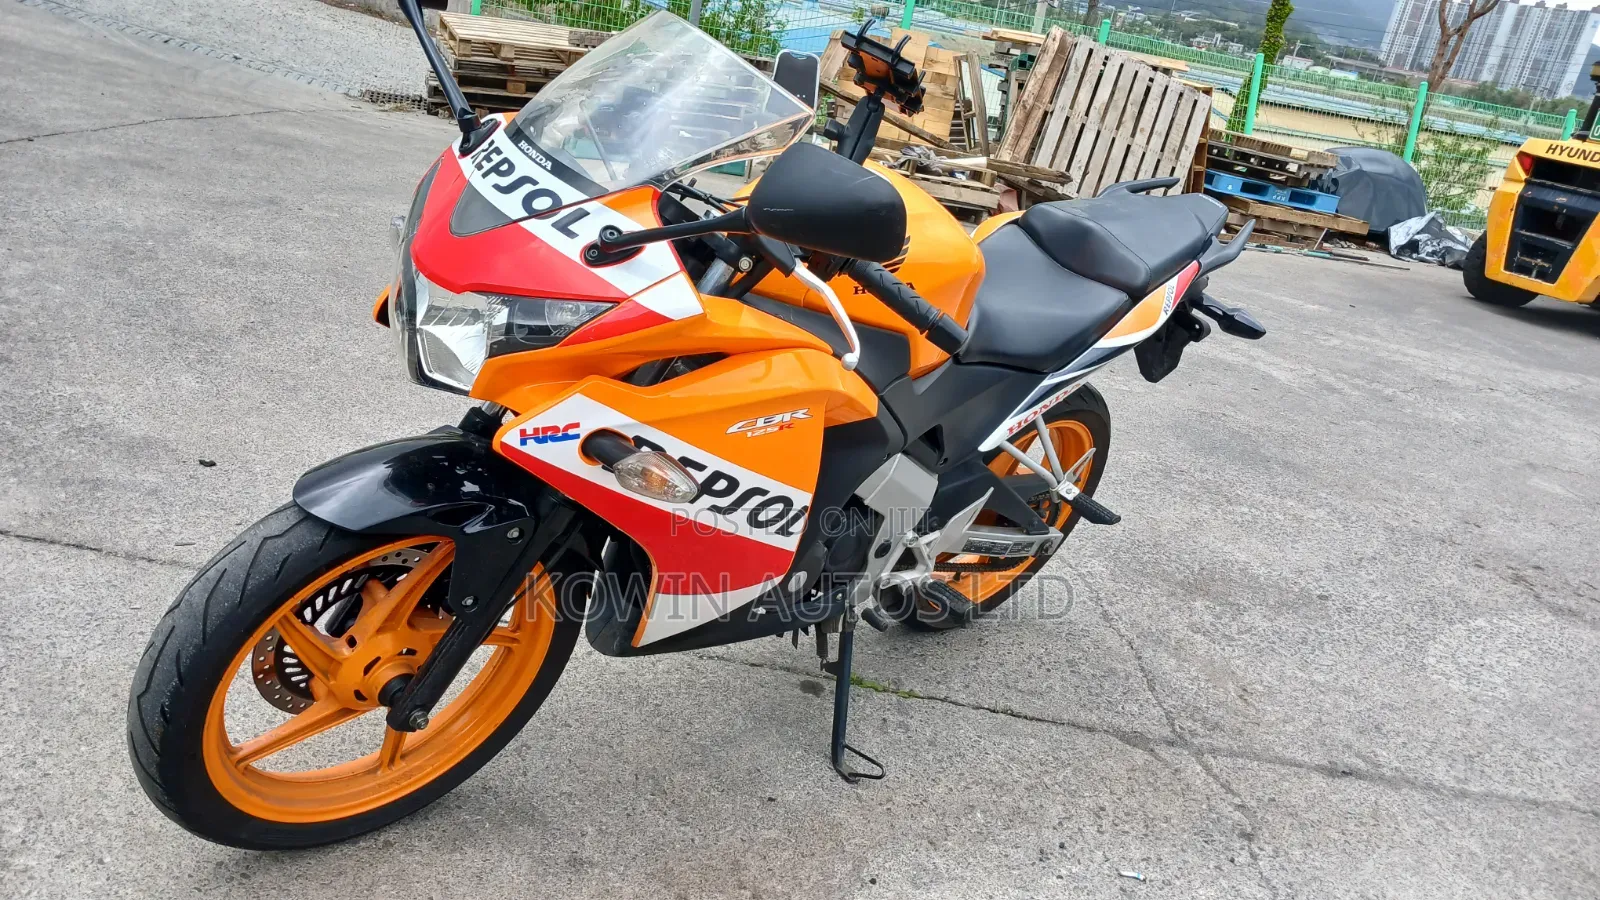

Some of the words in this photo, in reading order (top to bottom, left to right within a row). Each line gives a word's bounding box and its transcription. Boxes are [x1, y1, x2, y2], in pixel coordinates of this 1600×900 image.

[518, 139, 552, 171] HONDA
[1163, 284, 1175, 315] REPSOL
[725, 408, 813, 434] CBR
[1007, 383, 1081, 437] HONDA
[520, 422, 580, 446] HRC
